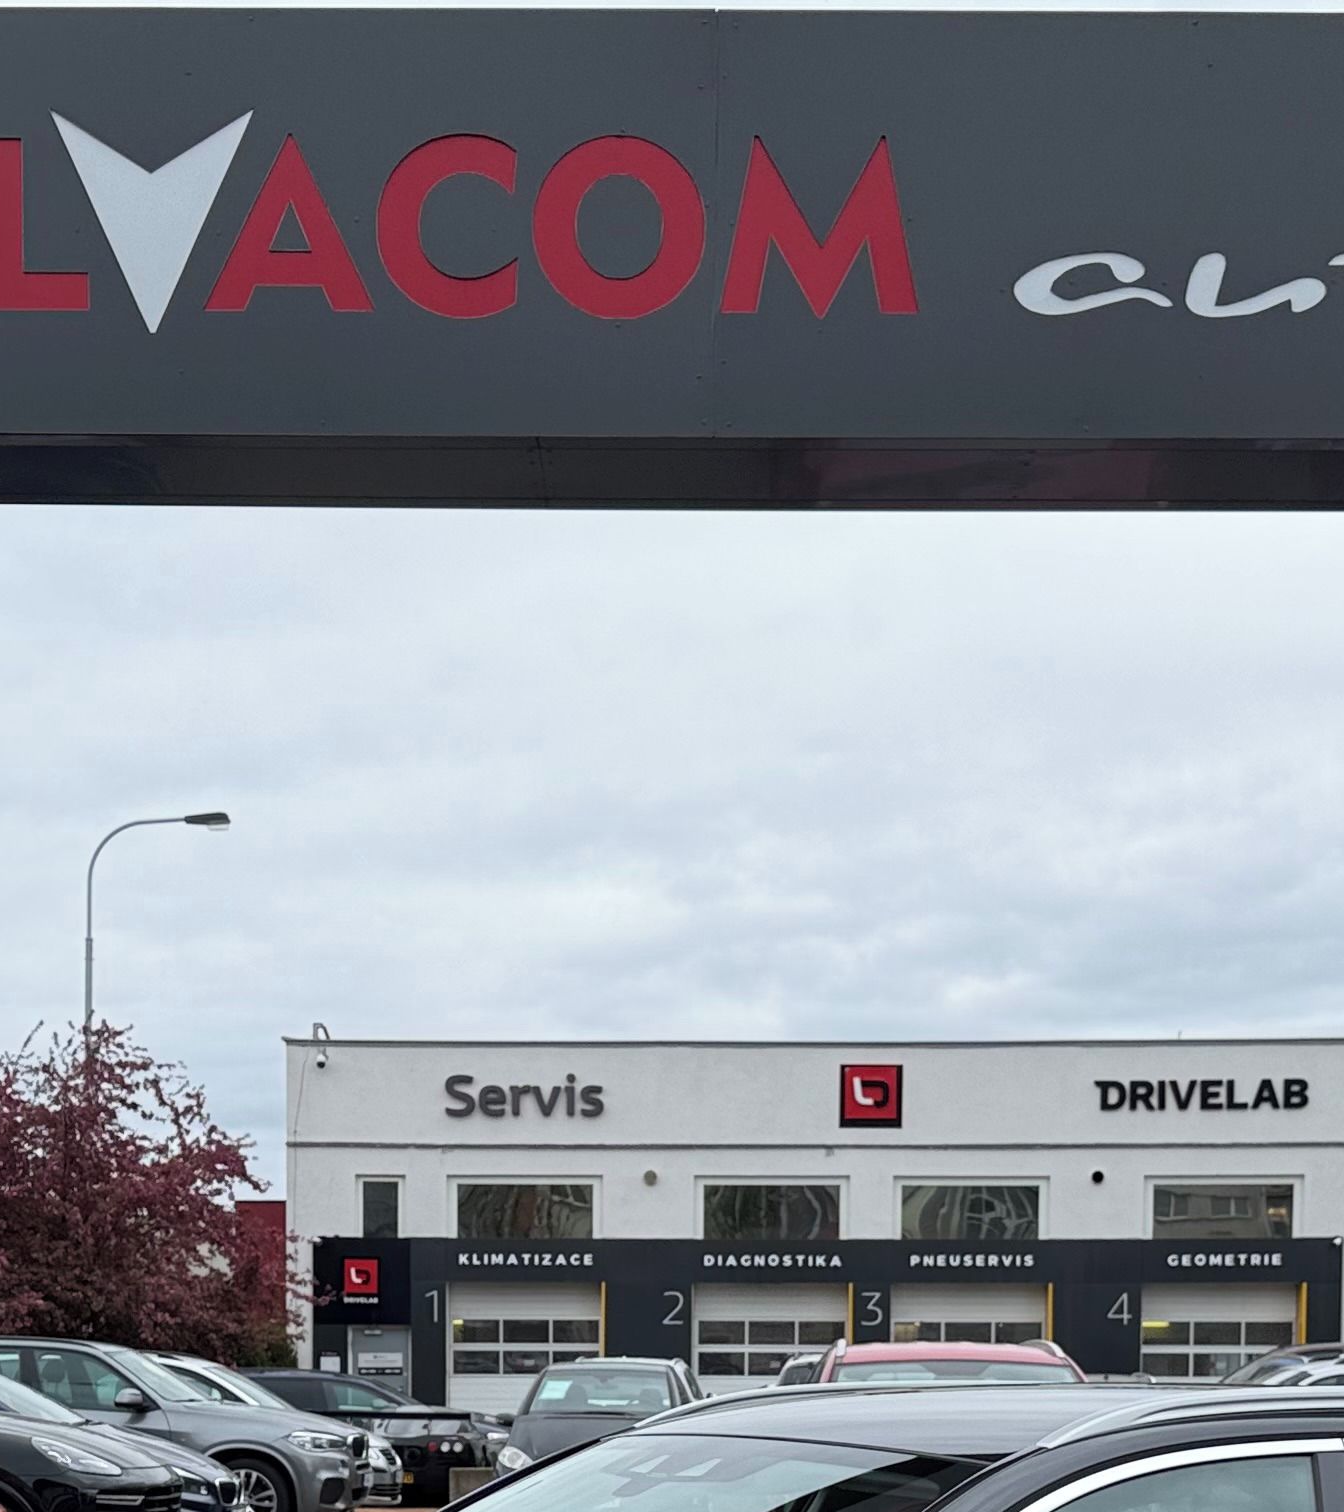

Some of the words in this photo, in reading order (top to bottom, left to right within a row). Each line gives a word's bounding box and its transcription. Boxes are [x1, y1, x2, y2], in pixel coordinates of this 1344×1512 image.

[444, 1073, 605, 1119] Servis
[1093, 1078, 1309, 1112] DRIVELAB
[458, 1252, 594, 1267] KLIMATIZACE
[703, 1253, 843, 1268] DIAGNOSTIKA
[909, 1254, 1035, 1268] PNEUSERVIS
[1166, 1253, 1283, 1267] GEOMETRIE
[425, 1290, 438, 1323] 1
[662, 1291, 684, 1325] 2
[860, 1291, 883, 1326] 3
[1106, 1292, 1132, 1325] 4
